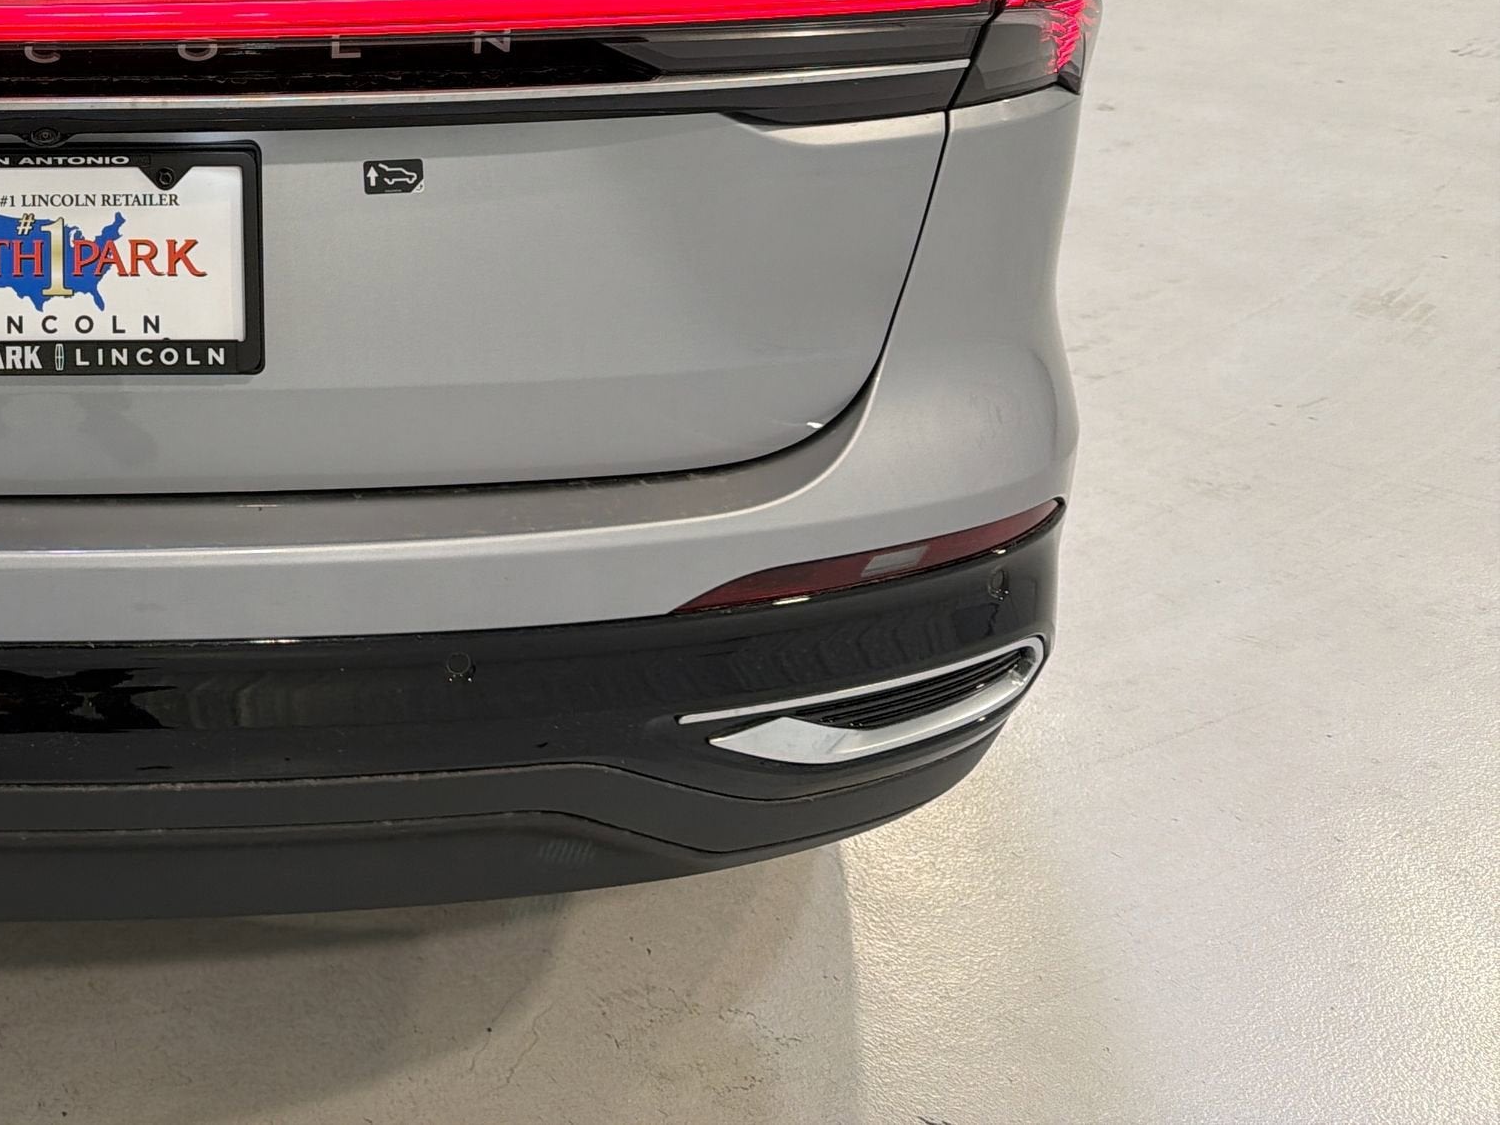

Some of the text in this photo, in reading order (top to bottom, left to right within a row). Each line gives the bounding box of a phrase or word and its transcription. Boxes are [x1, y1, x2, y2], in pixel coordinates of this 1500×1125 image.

[18, 156, 130, 166] ANTONIO
[0, 195, 16, 207] #1
[21, 194, 97, 207] LINCOLN
[100, 193, 180, 207] RETAILER
[72, 239, 208, 278] PARK
[75, 347, 226, 366] LINCOLN
